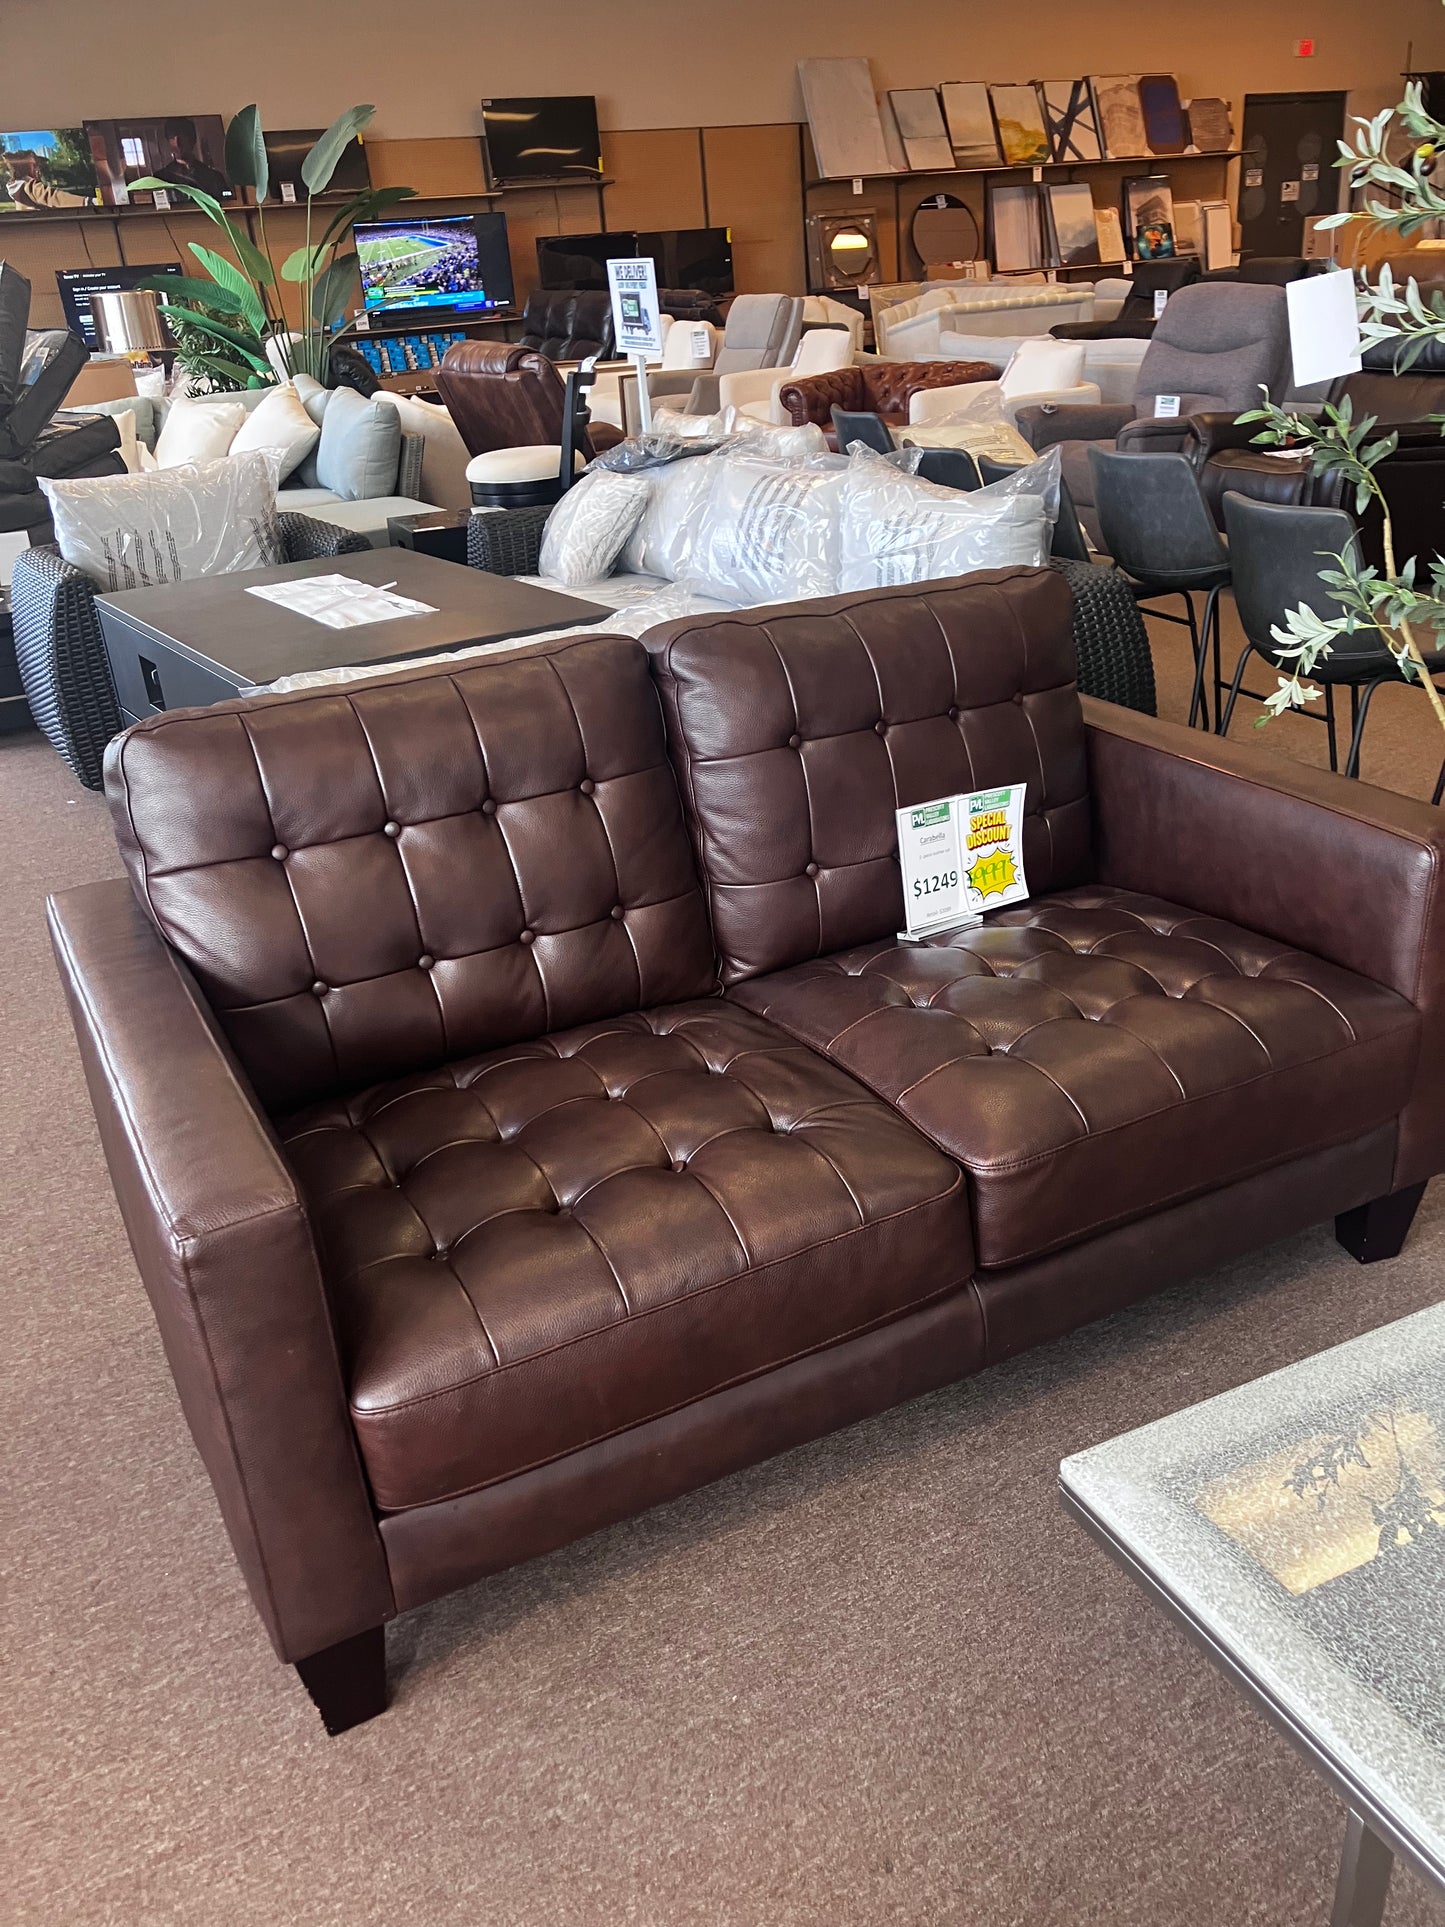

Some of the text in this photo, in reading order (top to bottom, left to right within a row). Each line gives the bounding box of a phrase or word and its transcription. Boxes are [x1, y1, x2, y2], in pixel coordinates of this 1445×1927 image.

[970, 810, 1006, 832] SPECIAL
[920, 832, 945, 845] Carabella
[966, 824, 1012, 850] DISCOUNT
[914, 870, 958, 900] $1249
